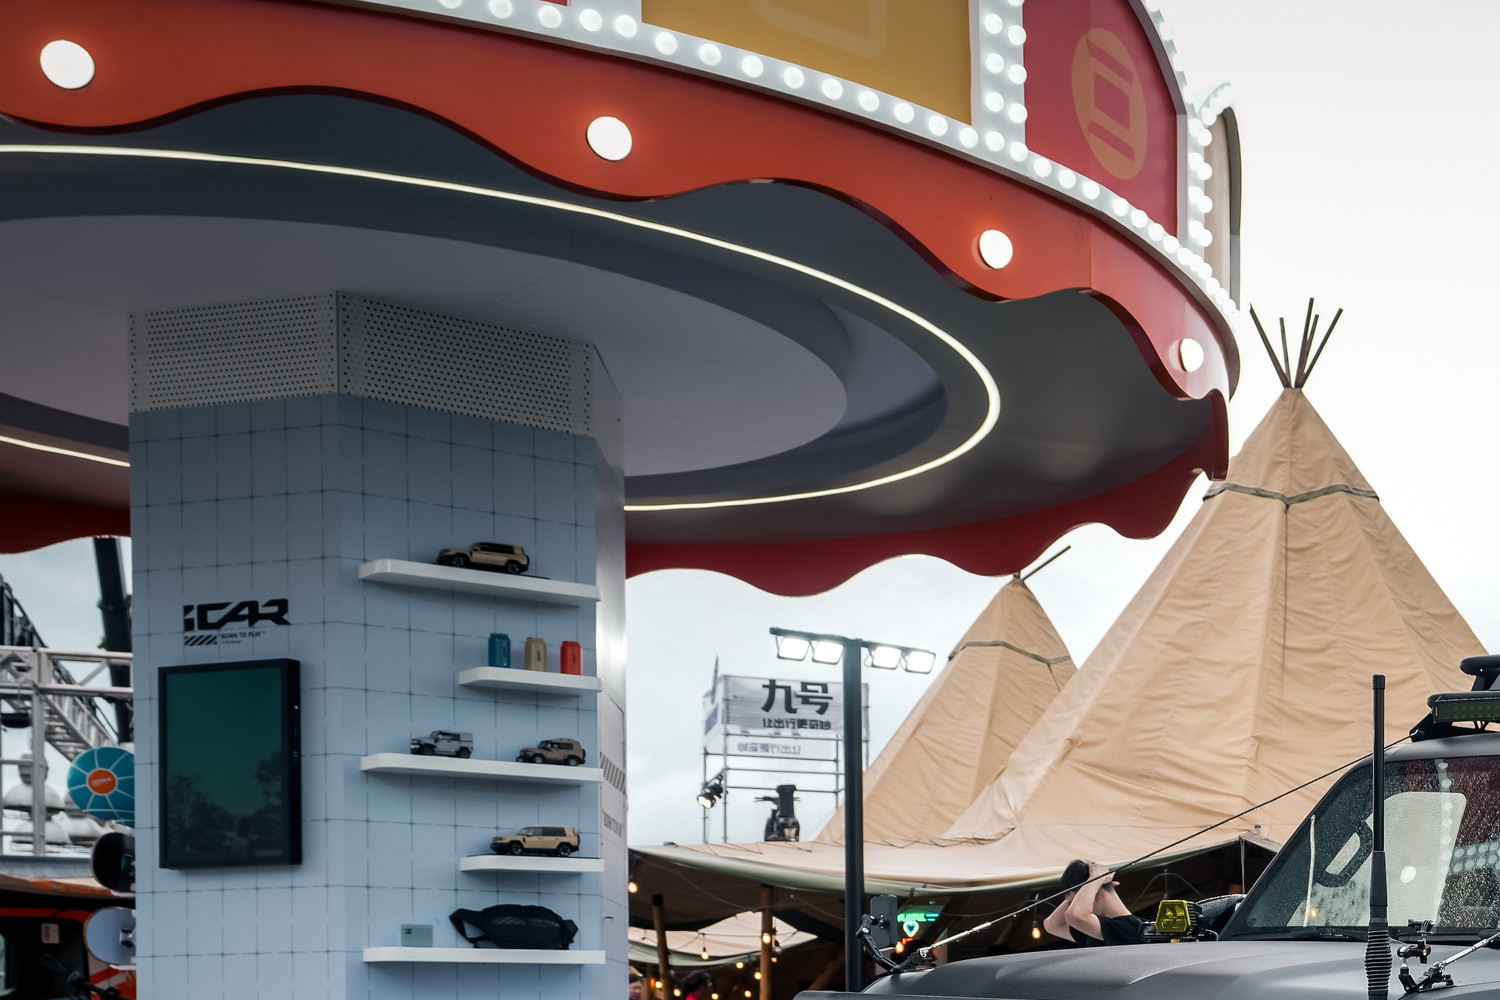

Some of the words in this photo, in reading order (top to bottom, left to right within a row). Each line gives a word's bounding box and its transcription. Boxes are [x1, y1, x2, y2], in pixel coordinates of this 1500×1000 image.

[761, 679, 833, 715] 九号
[763, 717, 832, 731] 让出行更奇妙
